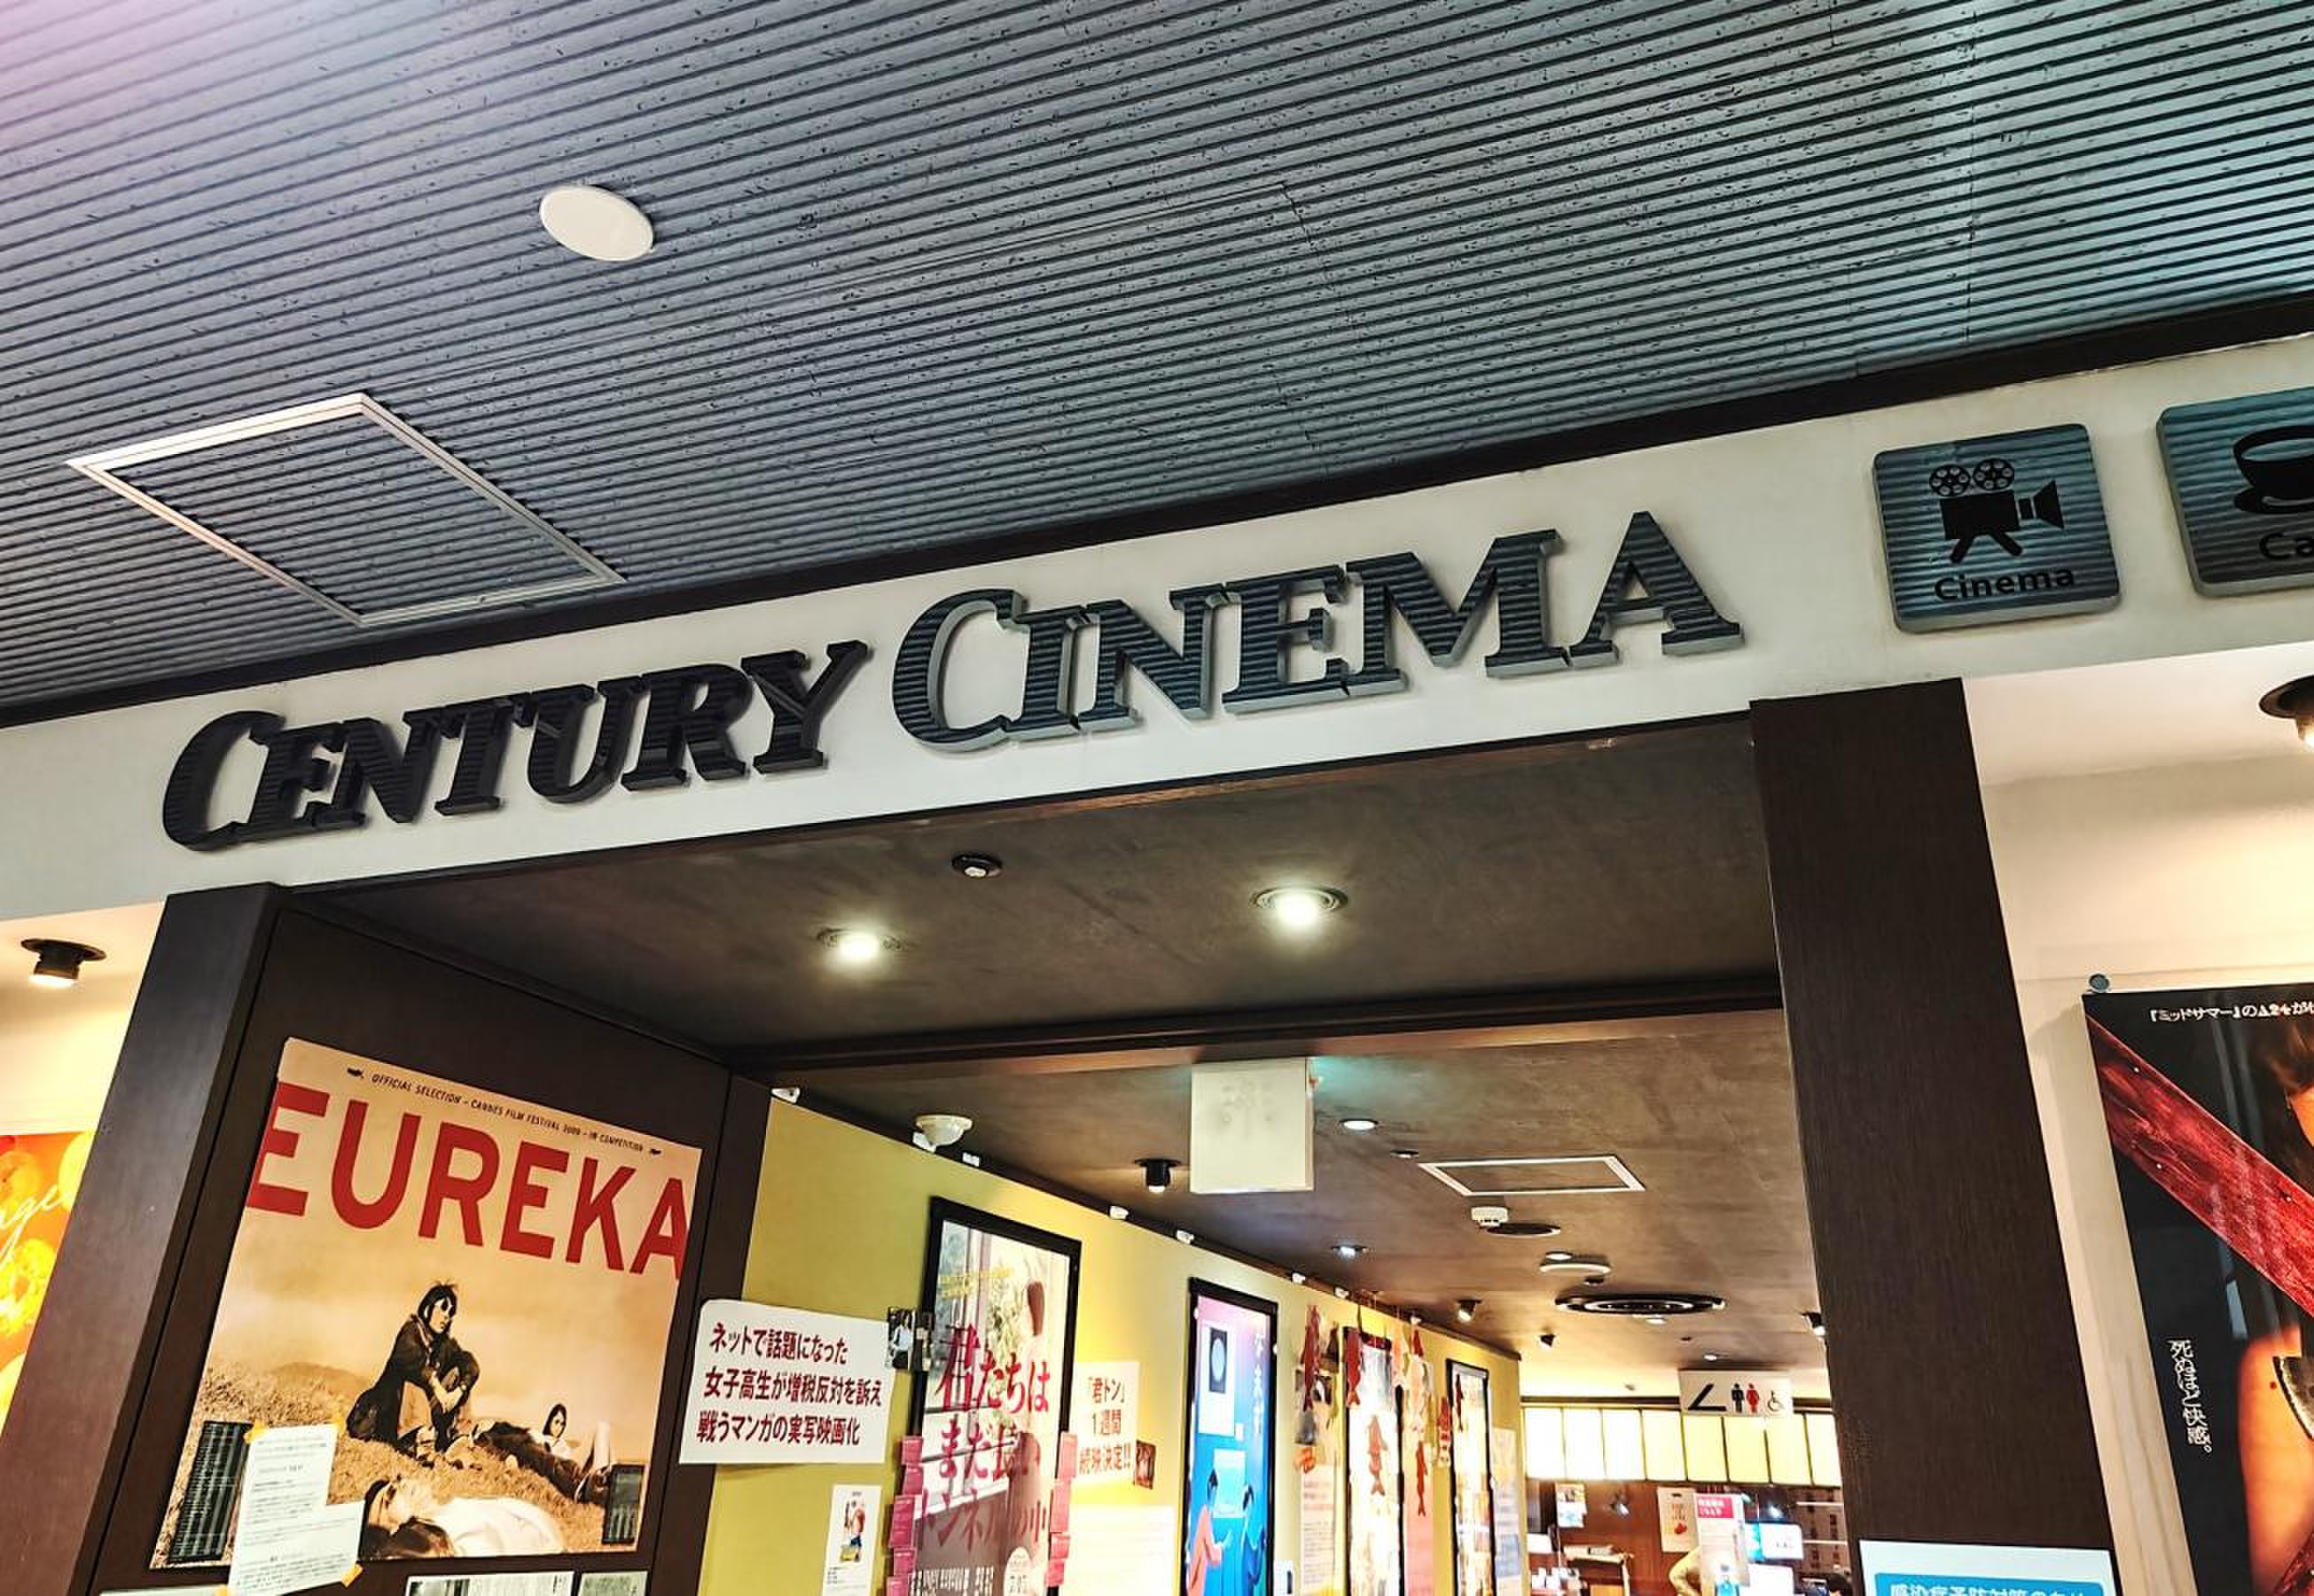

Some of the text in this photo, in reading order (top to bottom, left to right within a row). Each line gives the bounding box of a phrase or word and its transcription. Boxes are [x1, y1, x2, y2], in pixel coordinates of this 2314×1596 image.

[1934, 569, 2074, 600] Cinema
[163, 511, 1744, 852] CENTURY CINEMA
[371, 1073, 412, 1091] OFFICIAL
[415, 1085, 462, 1104] SELECTION
[504, 1108, 525, 1122] FILM
[526, 1113, 560, 1132] FESTIVAL
[246, 1082, 690, 1280] EUREKA
[709, 1322, 849, 1365] ネットで話題になった
[703, 1365, 882, 1406] 女子高生が増税反対を訴え
[697, 1409, 860, 1446] 戦うマンガの実写映画化
